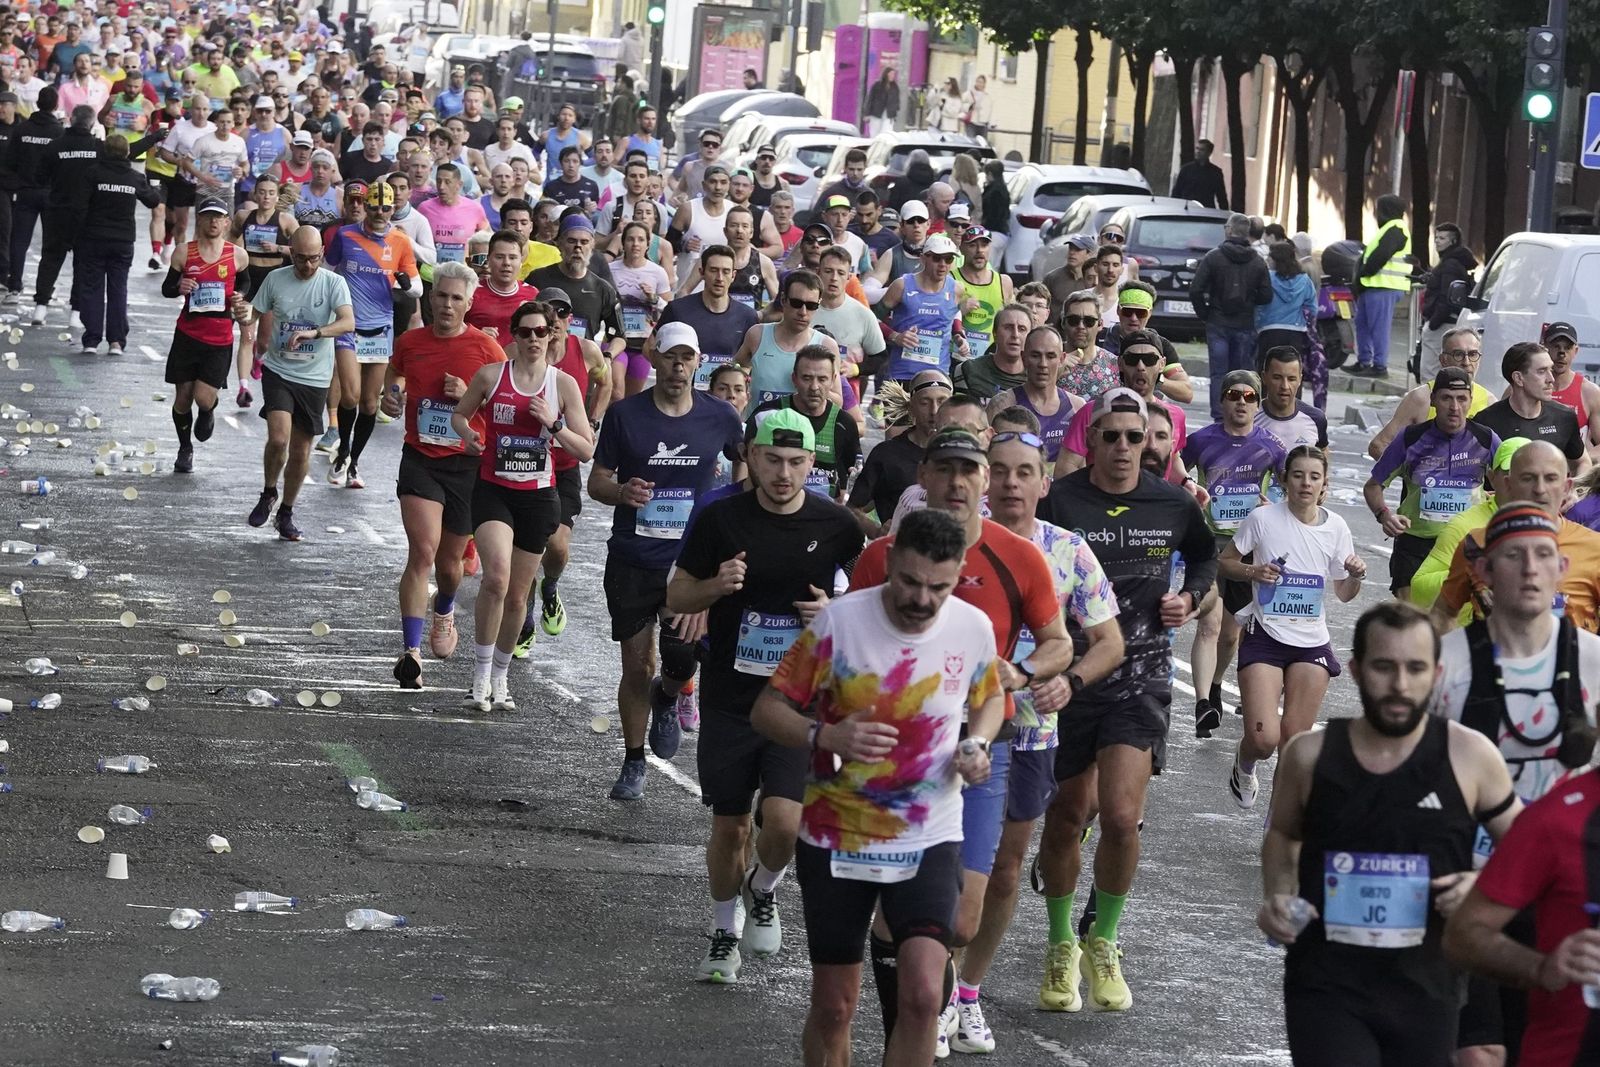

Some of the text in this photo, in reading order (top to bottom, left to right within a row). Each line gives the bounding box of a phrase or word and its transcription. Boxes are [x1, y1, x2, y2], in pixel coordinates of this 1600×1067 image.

[59, 151, 97, 159] VOLUNTEER
[98, 184, 136, 194] VOLUNTEER
[967, 331, 988, 339] ZURICH
[432, 415, 447, 423] 5787
[428, 424, 447, 435] EDD
[1046, 429, 1064, 438] AGEN
[1451, 452, 1468, 461] AGEN
[505, 461, 537, 471] HONOR
[1235, 464, 1252, 473] AGEN
[1228, 486, 1255, 494] ZURICH
[656, 505, 674, 513] 6939
[1424, 501, 1467, 512] LAURENT
[1087, 528, 1116, 545] edp
[1128, 529, 1172, 537] Maratona
[1128, 538, 1166, 546] do Porto
[1147, 548, 1170, 556] 2025
[1286, 577, 1318, 586] ZURICH
[1273, 602, 1314, 614] LOANNE
[764, 617, 800, 627] ZURICH
[763, 637, 784, 645] 6838
[737, 646, 763, 660] IVAN
[1359, 858, 1417, 872] ZURICH
[1363, 905, 1386, 923] JC
